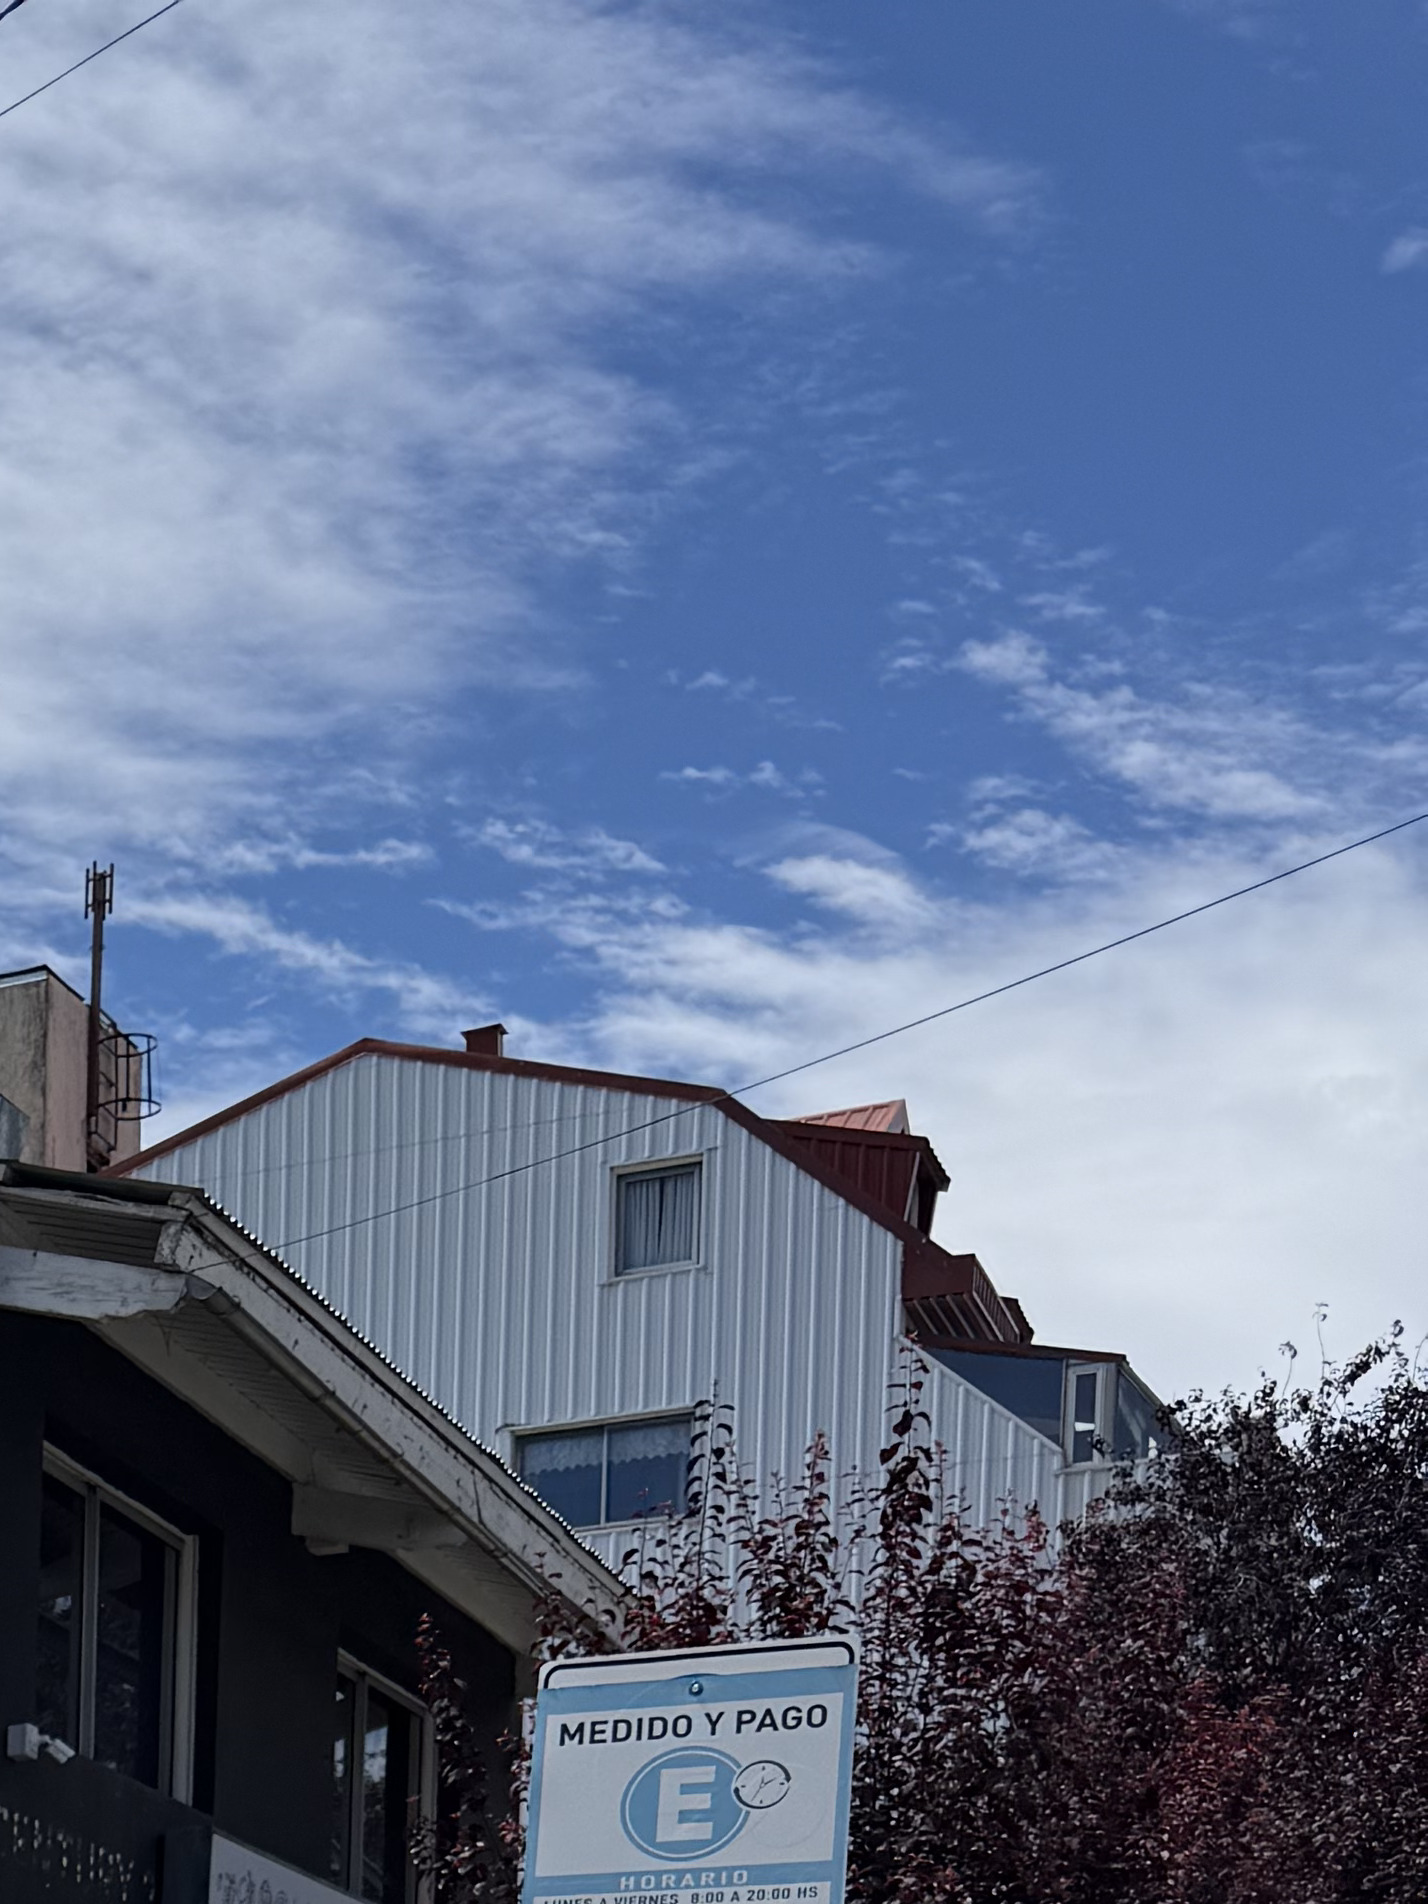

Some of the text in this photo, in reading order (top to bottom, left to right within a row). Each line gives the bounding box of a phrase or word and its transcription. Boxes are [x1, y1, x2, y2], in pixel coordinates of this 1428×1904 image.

[559, 1704, 828, 1747] MEDIDO Y PAGO
[656, 1765, 716, 1843] E
[619, 1870, 748, 1890] HORARIO
[731, 1890, 740, 1902] A
[747, 1888, 790, 1901] 20:00
[797, 1886, 818, 1898] HS
